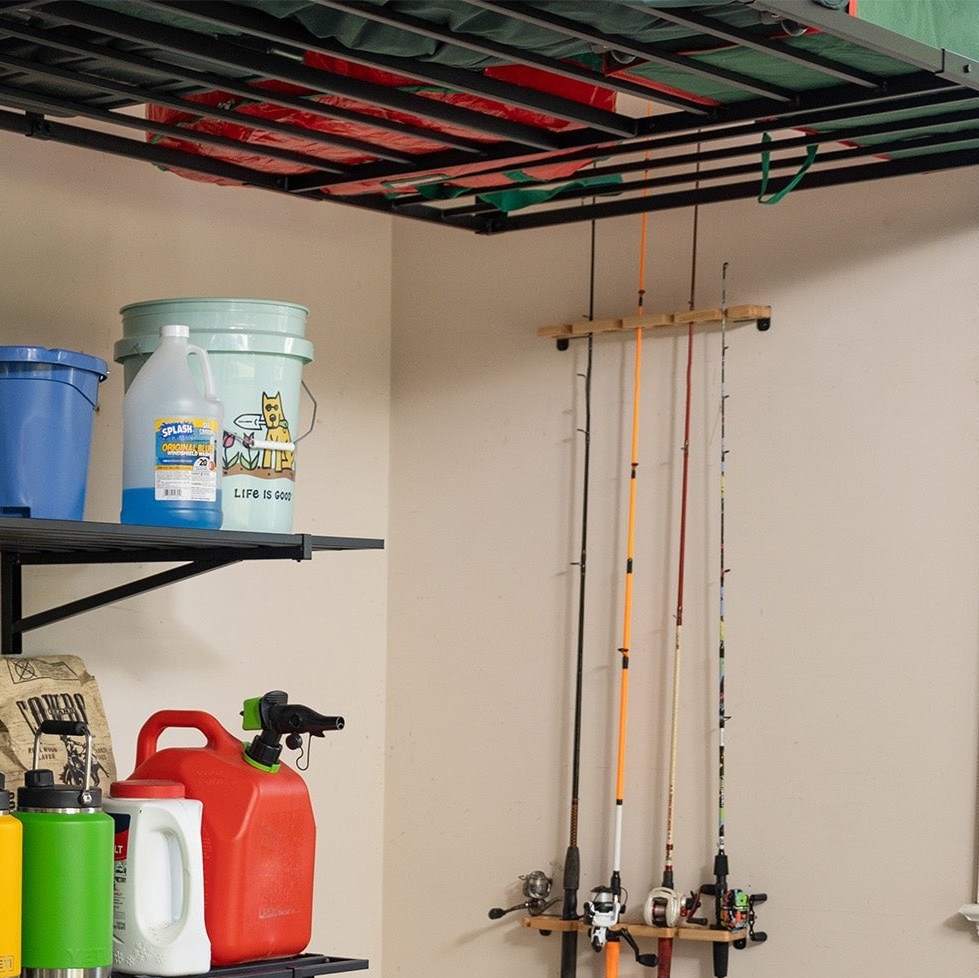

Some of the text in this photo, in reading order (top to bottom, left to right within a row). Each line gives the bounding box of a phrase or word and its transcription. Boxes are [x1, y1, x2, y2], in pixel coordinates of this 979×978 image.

[162, 424, 192, 438] SPLASH
[162, 443, 194, 452] ORIGINAL
[263, 490, 272, 500] IS
